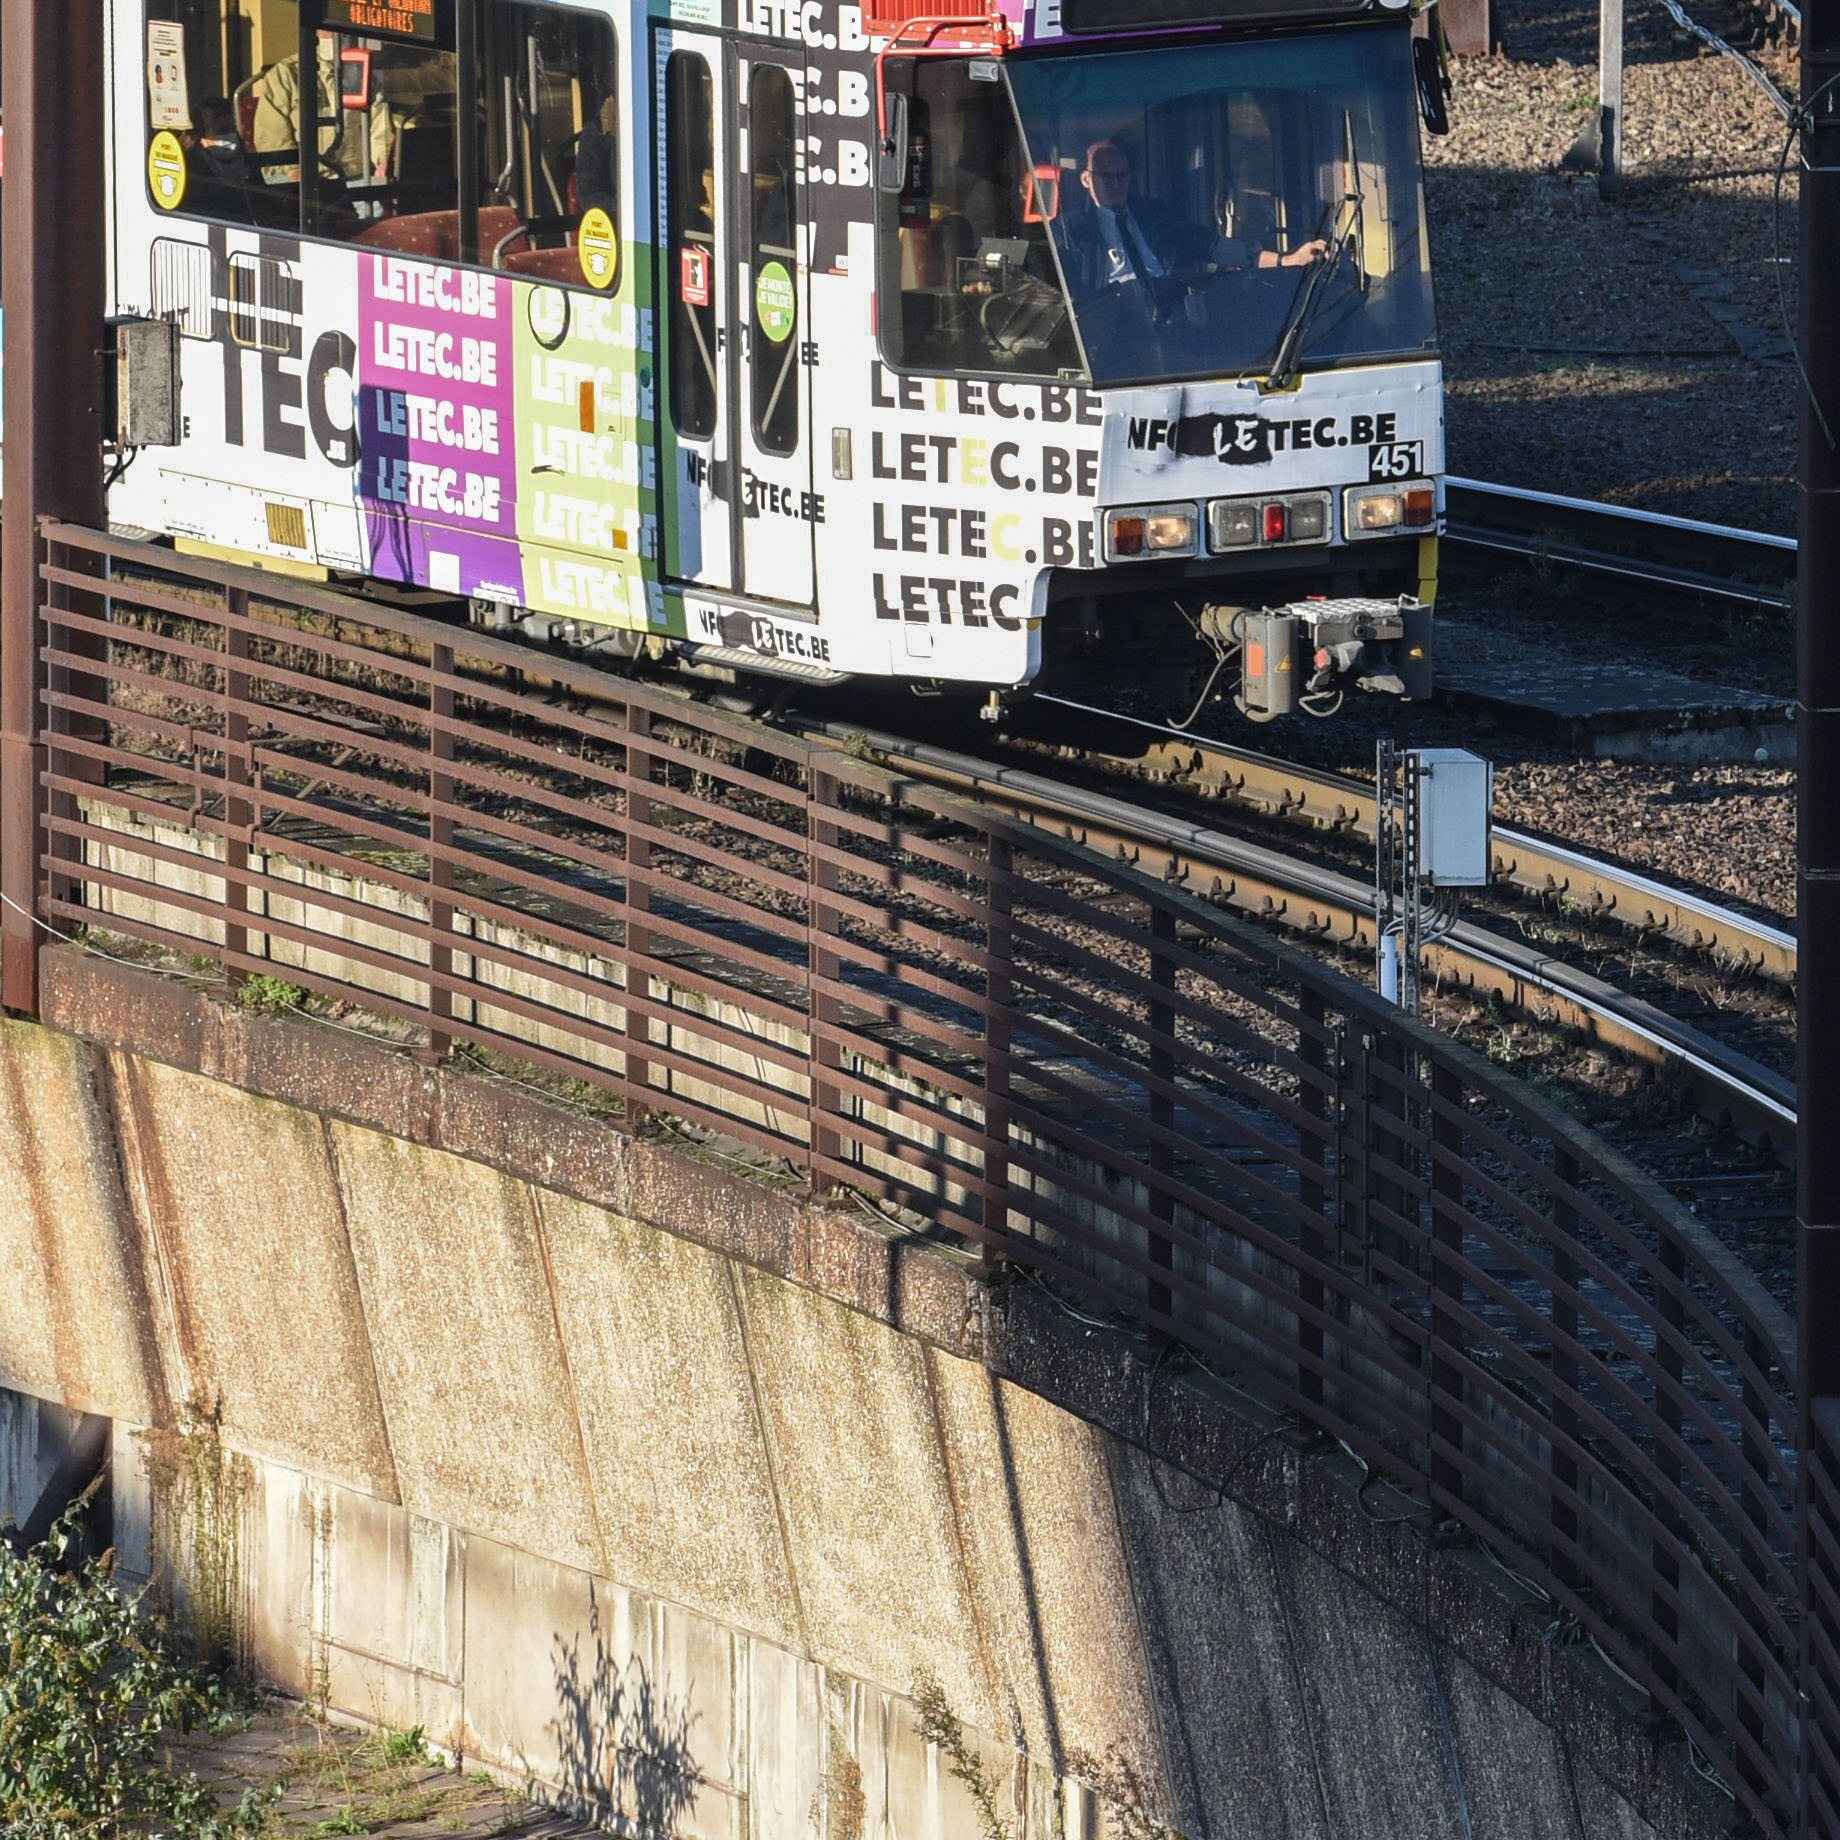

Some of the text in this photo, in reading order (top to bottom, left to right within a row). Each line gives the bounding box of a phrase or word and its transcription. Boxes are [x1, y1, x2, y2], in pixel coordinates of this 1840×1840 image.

[373, 254, 497, 319] LETEC.BE
[374, 320, 498, 387] LETEC.BE
[375, 388, 500, 455] LETEC.BE
[376, 455, 501, 523] LETEC.BE
[871, 431, 1099, 498] LETEC.BE
[1371, 441, 1423, 479] 451
[872, 573, 1022, 632] LETEC
